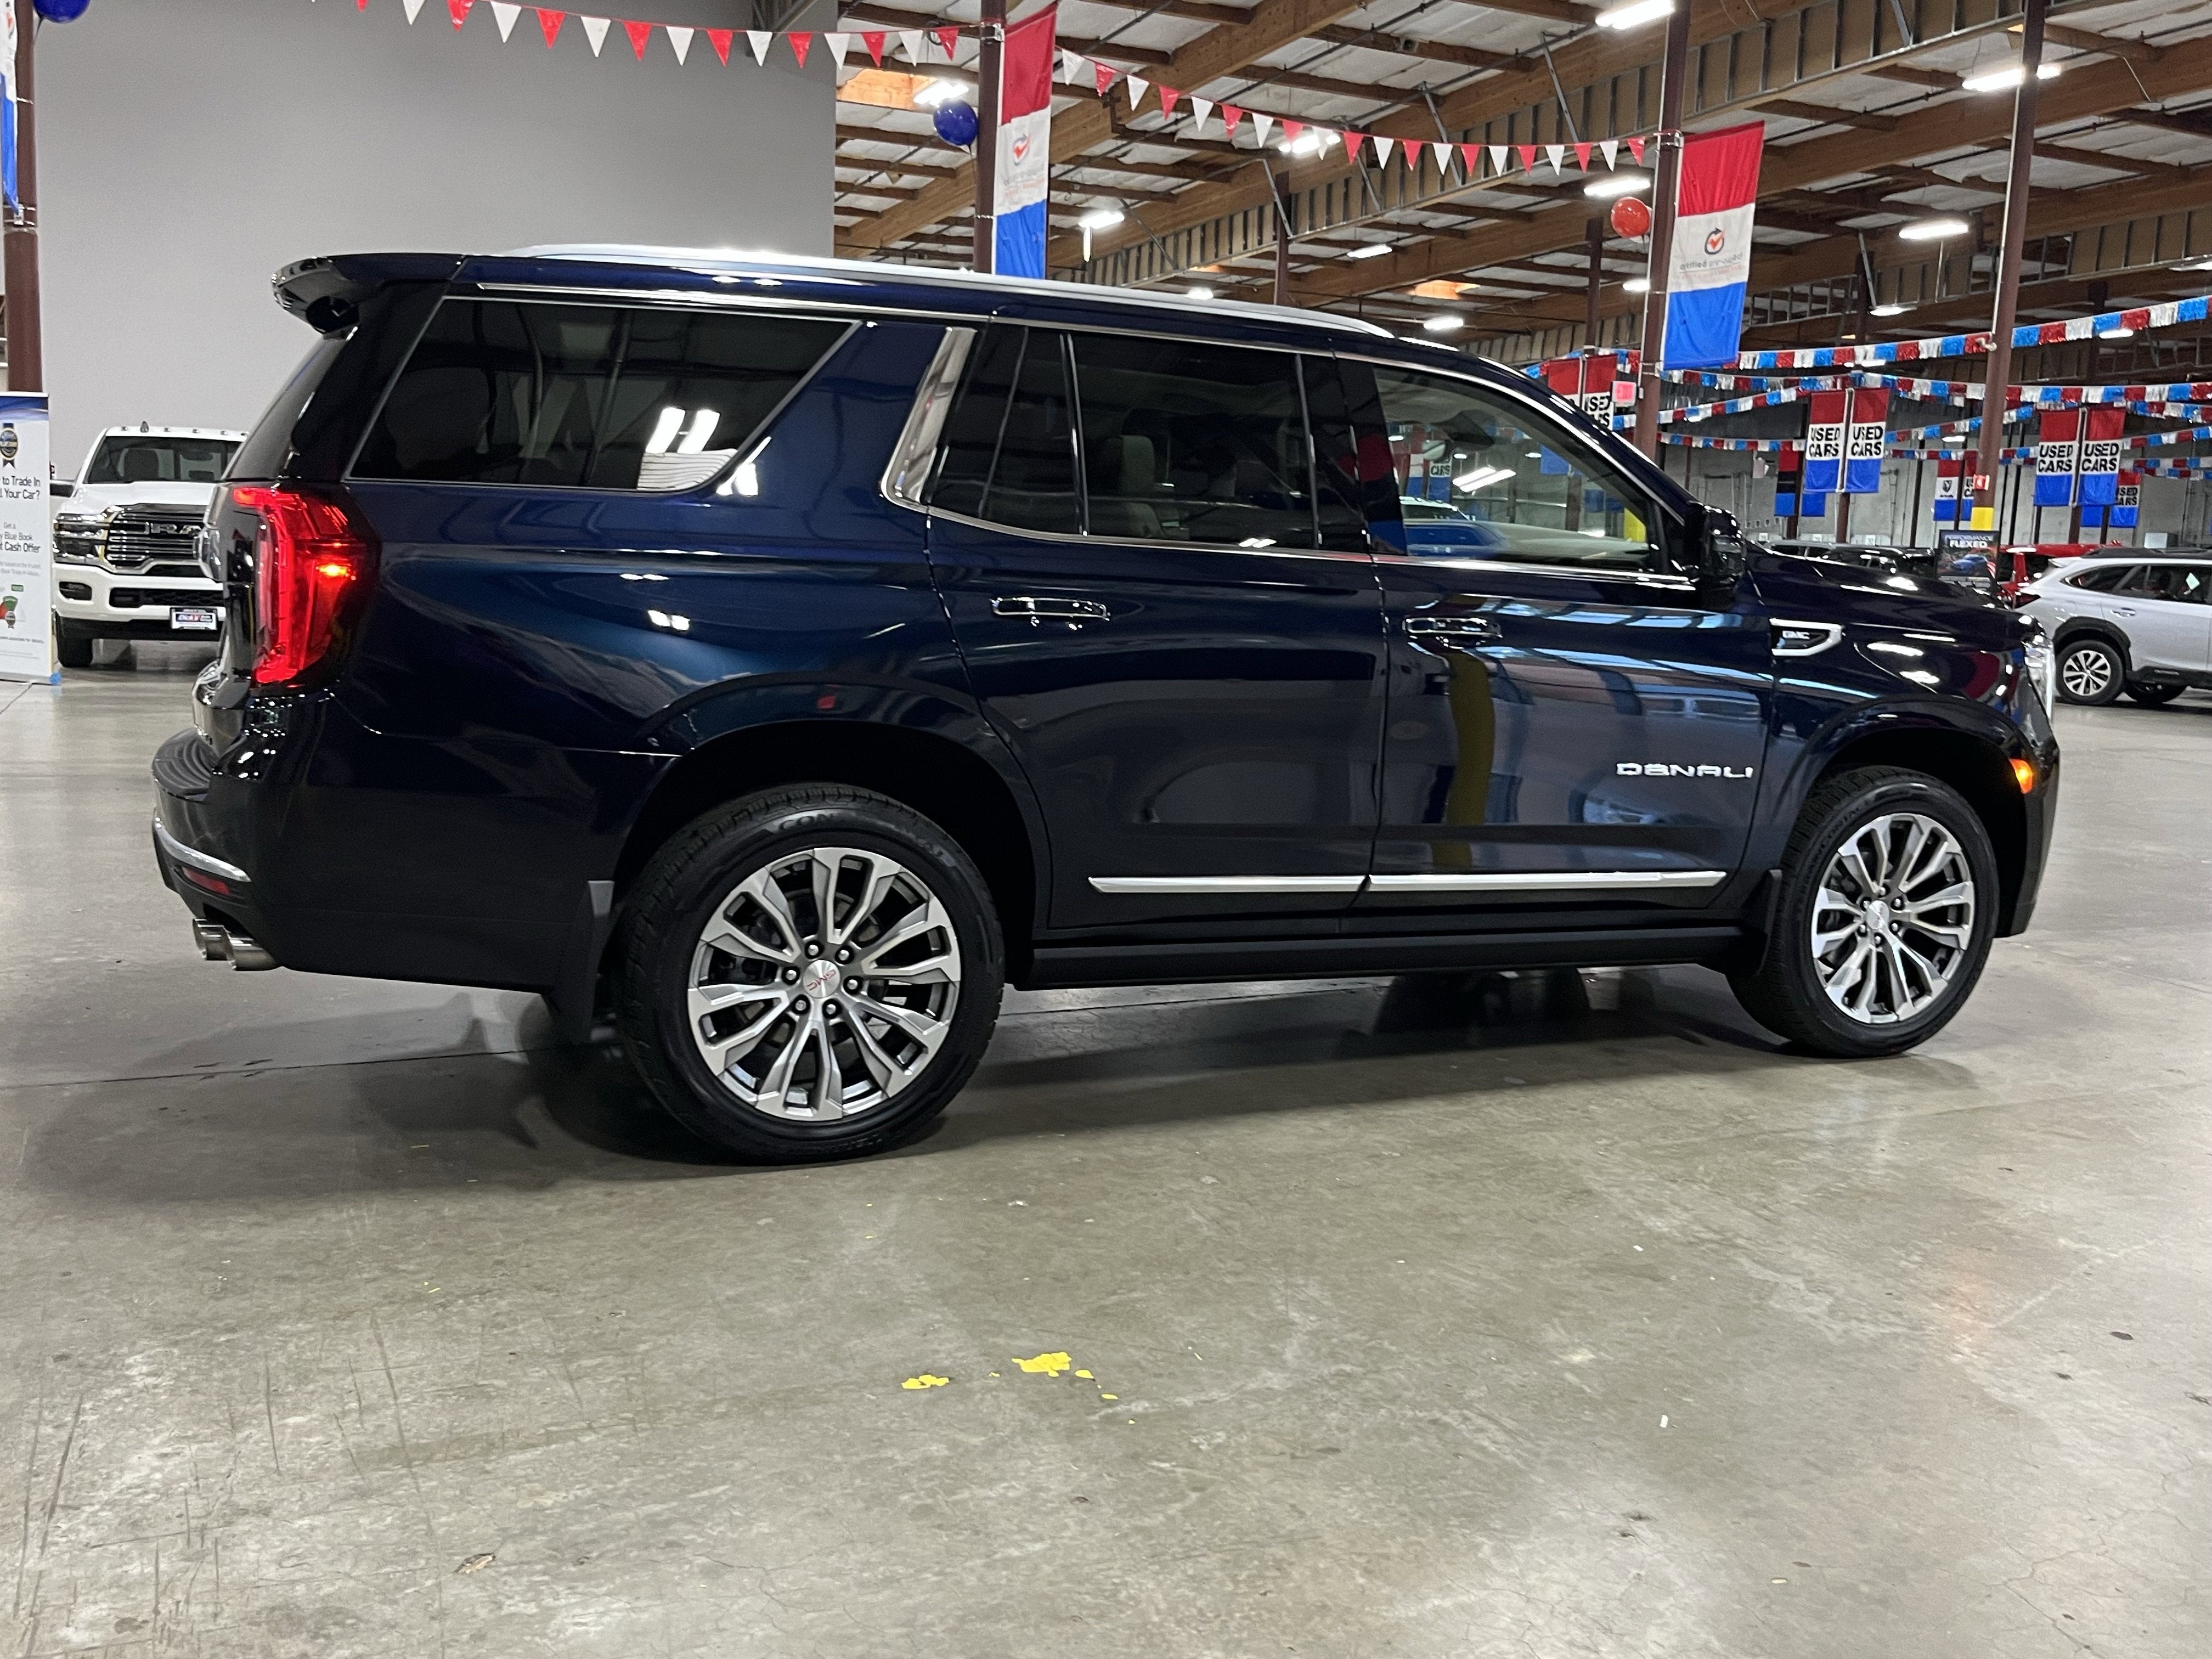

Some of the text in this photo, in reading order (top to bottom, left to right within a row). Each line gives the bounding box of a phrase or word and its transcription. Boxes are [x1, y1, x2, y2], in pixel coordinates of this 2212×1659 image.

[1811, 427, 1841, 441] USED
[1853, 426, 1883, 440] USED
[1809, 443, 1839, 457] CARS
[1850, 442, 1882, 456] CARS
[2040, 444, 2073, 458] USED
[2085, 443, 2119, 457] USED
[2038, 459, 2072, 472] CARS
[2081, 458, 2117, 472] CARS
[11, 476, 32, 486] Trade
[4, 488, 21, 499] Your
[23, 489, 40, 500] Car?
[4, 542, 21, 552] Cash
[24, 543, 41, 553] Offer
[1950, 540, 1988, 548] FLEXED
[1616, 763, 1753, 778] DENALI
[807, 969, 837, 991] GMC
